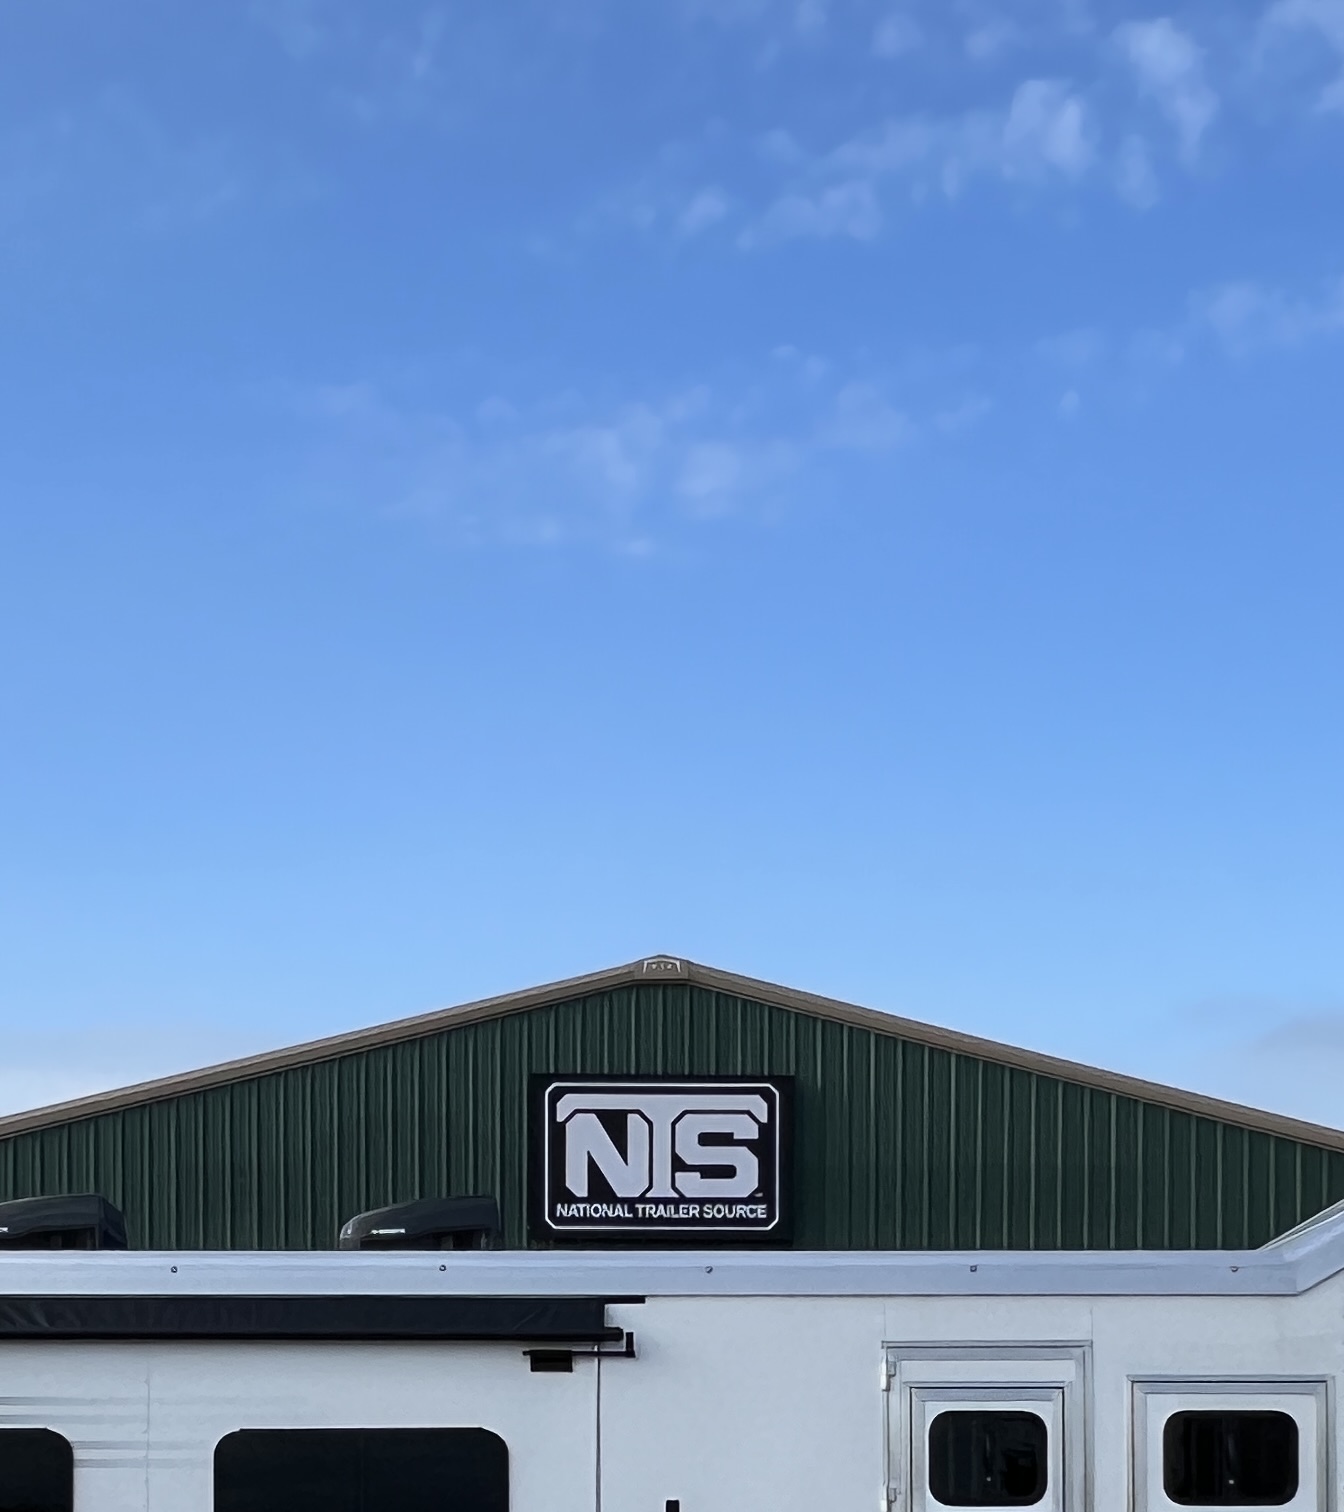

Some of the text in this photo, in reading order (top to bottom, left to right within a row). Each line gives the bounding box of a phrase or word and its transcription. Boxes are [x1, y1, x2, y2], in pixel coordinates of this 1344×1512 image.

[556, 1093, 768, 1198] NTS
[556, 1203, 767, 1218] NATIONAL TRAILER SOURCE
